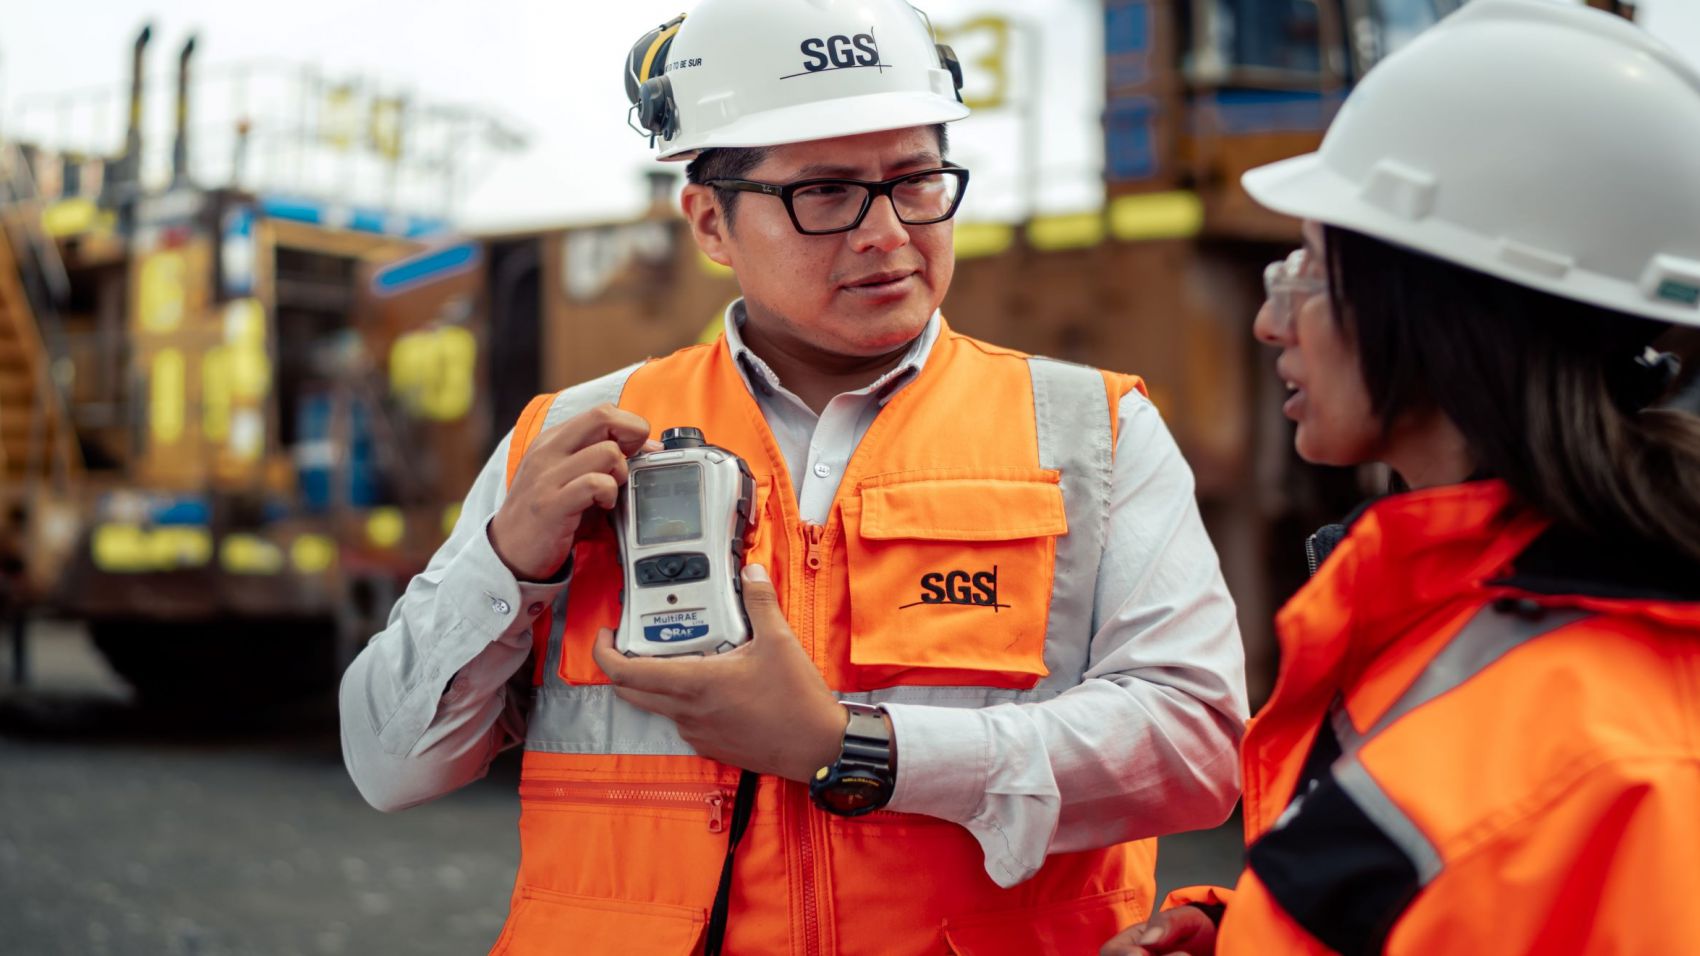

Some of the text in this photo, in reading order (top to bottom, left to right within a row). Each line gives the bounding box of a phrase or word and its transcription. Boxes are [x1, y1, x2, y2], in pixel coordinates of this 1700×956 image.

[680, 59, 687, 69] BE
[800, 33, 880, 71] SGS
[920, 570, 996, 606] SGS
[653, 612, 698, 625] MultiRAE
